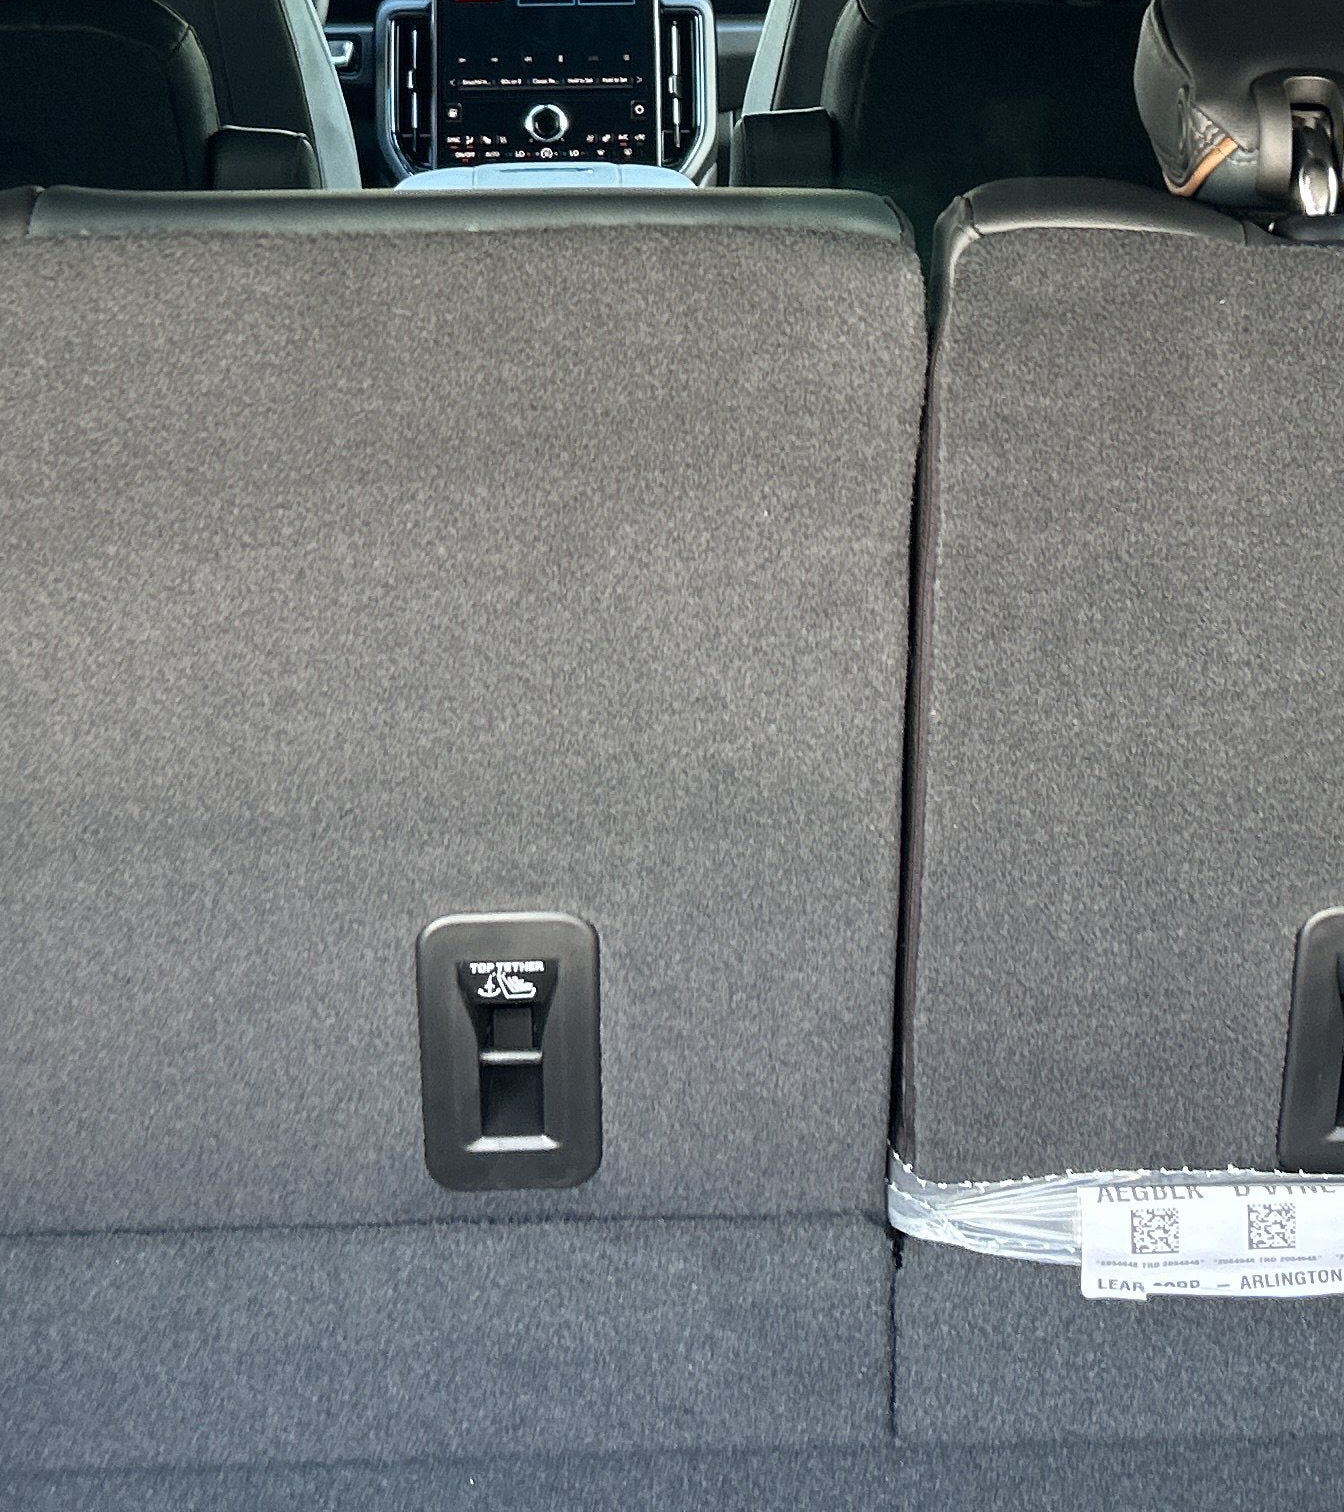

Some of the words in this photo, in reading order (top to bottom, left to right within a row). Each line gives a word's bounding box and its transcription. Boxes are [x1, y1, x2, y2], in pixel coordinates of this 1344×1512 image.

[469, 962, 496, 975] TOP
[496, 961, 545, 973] TETHER
[1098, 1278, 1145, 1292] LEAR
